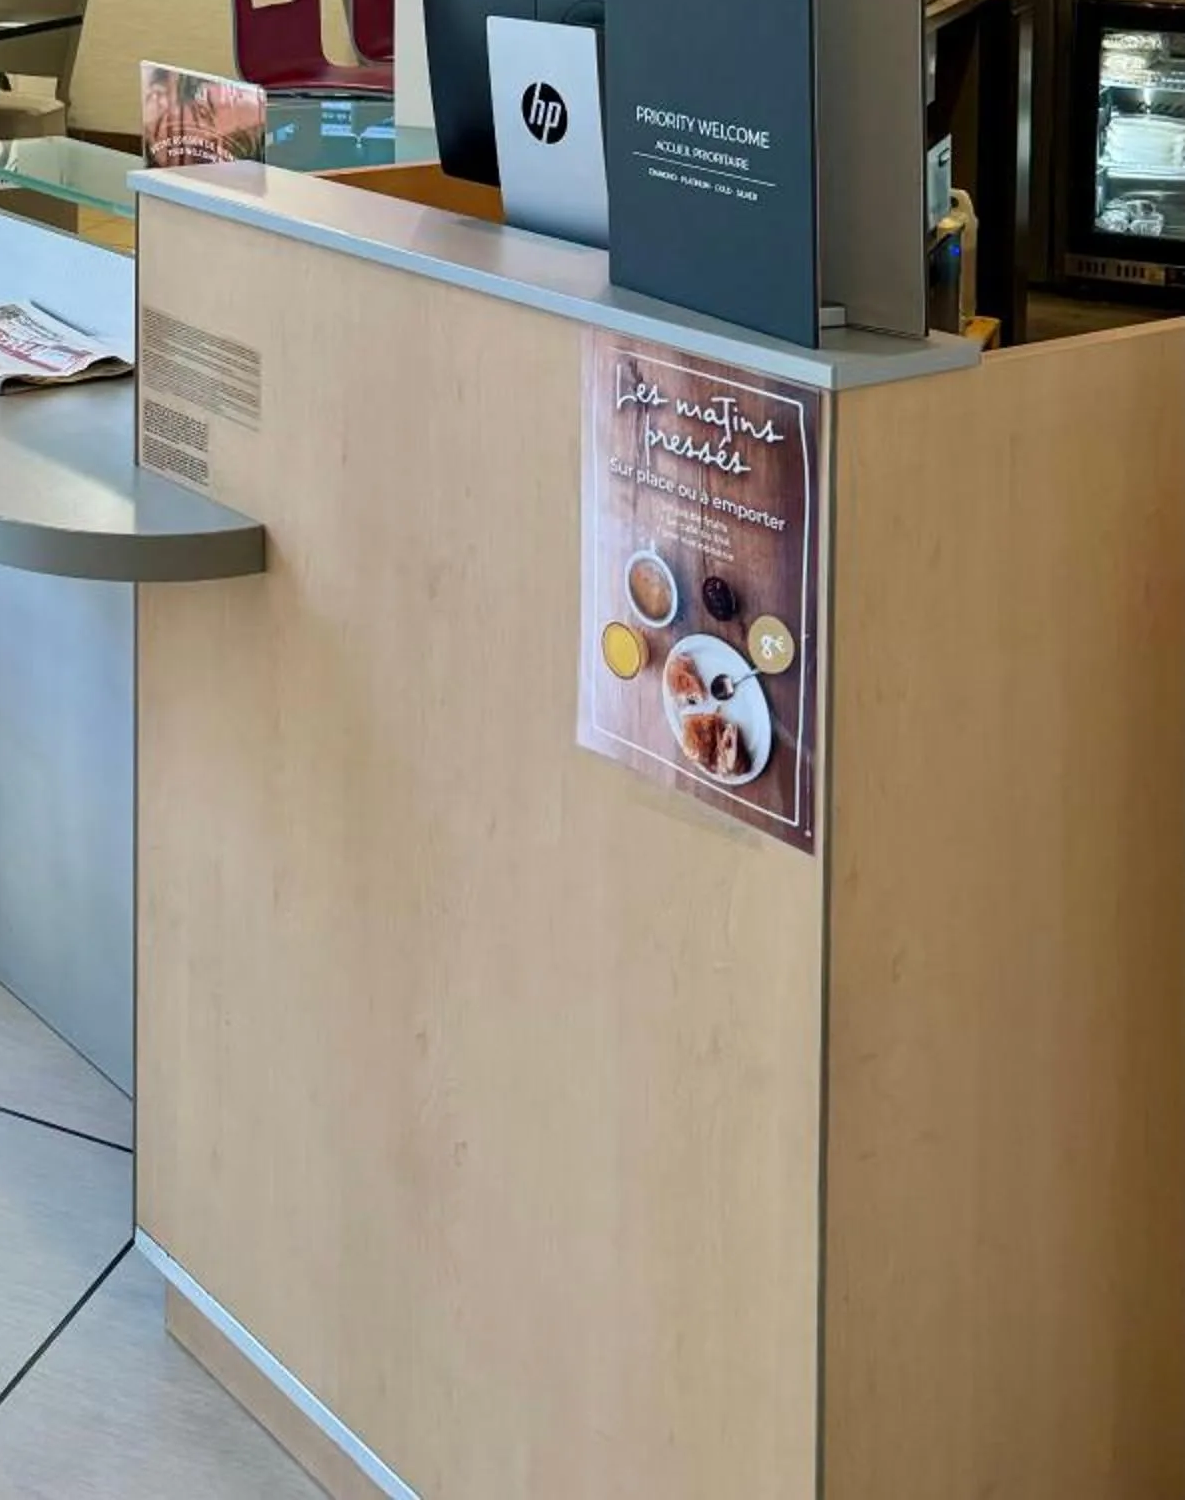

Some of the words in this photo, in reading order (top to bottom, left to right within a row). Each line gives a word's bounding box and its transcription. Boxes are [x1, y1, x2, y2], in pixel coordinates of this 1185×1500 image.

[526, 82, 564, 144] hp
[636, 105, 696, 132] PRIORITY
[698, 120, 770, 148] WELCOME
[654, 140, 691, 157] ACCUEIL
[692, 147, 750, 171] PRIORITAIRE
[616, 364, 668, 409] Les
[645, 413, 752, 474] pressés
[610, 457, 634, 477] Sur
[637, 467, 676, 493] place
[678, 485, 697, 500] ou
[699, 489, 709, 505] à
[712, 497, 786, 531] emporter
